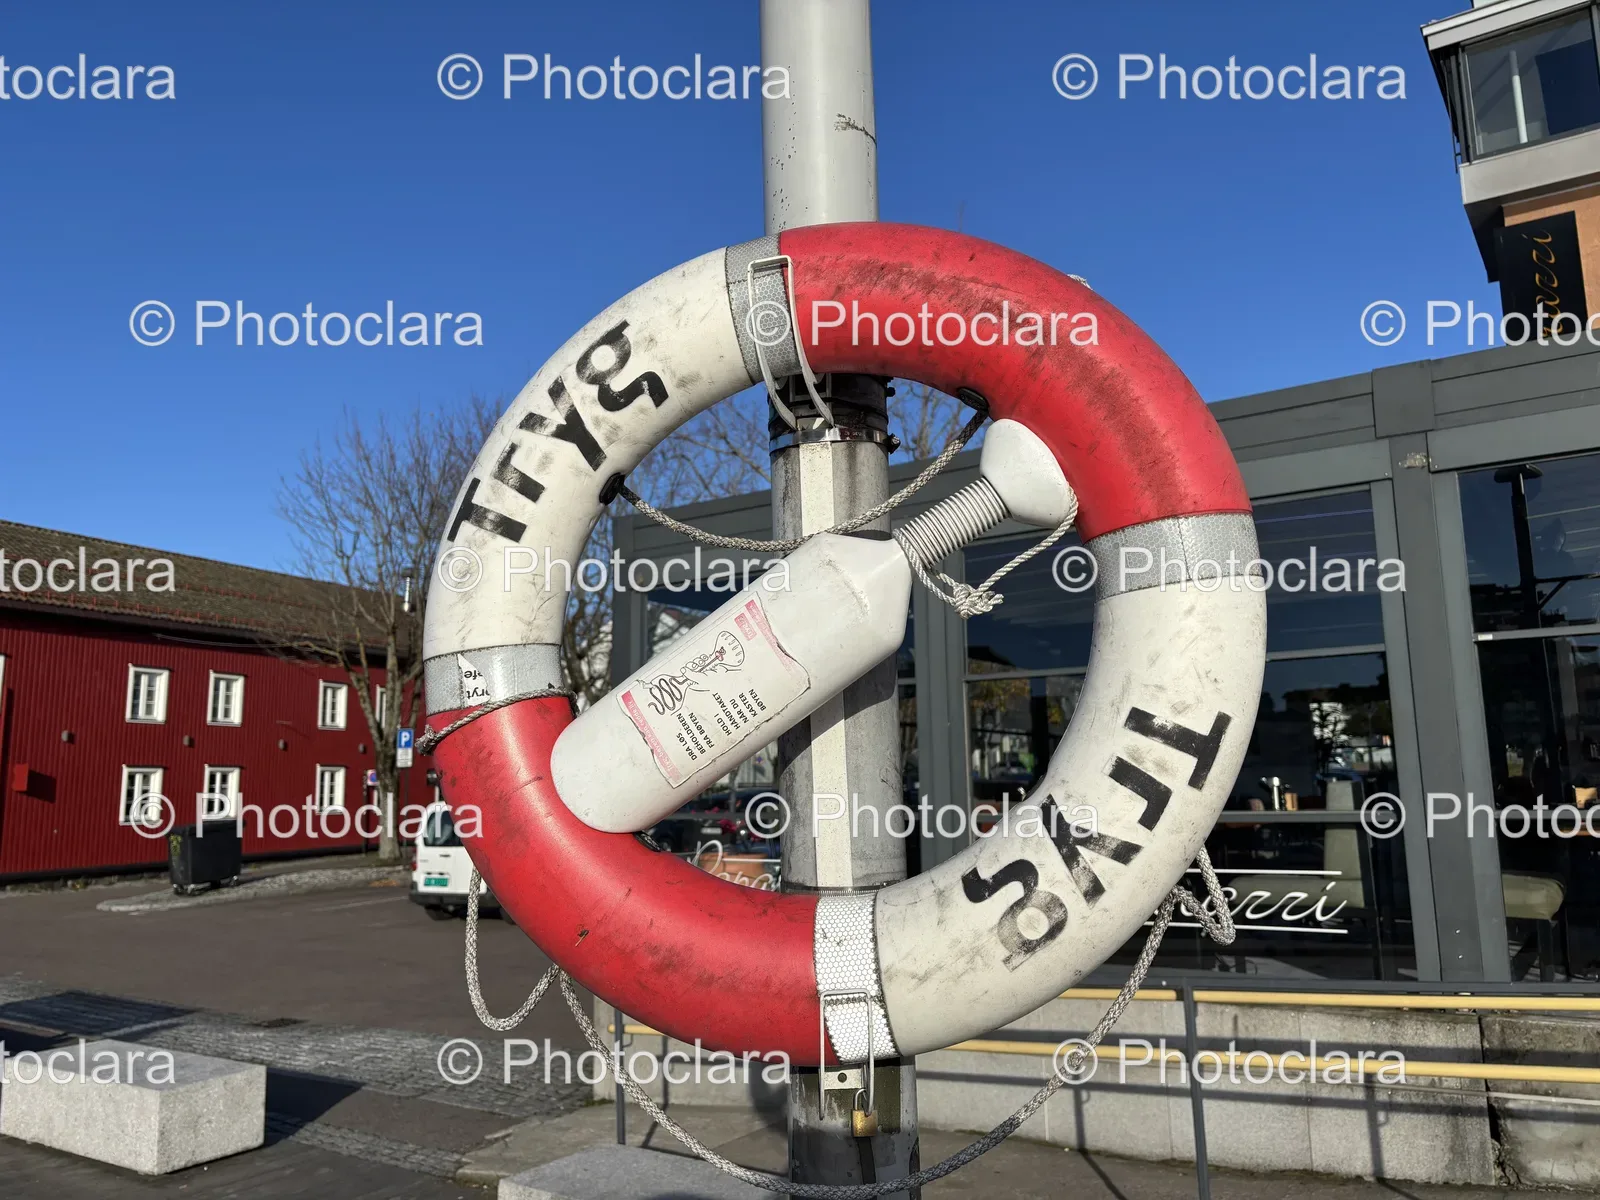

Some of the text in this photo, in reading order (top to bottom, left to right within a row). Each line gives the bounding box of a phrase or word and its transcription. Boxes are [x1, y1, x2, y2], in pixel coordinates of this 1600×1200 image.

[712, 692, 740, 730] HÅNDTAKET
[729, 698, 749, 723] NÅR DU
[738, 692, 758, 717] KASTER
[748, 688, 766, 711] BØYEN
[676, 712, 706, 755] BEHOLDEREN
[688, 712, 715, 748] FRA BØYEN
[716, 717, 732, 736] HOLD
[676, 732, 698, 761] DRA LØS
